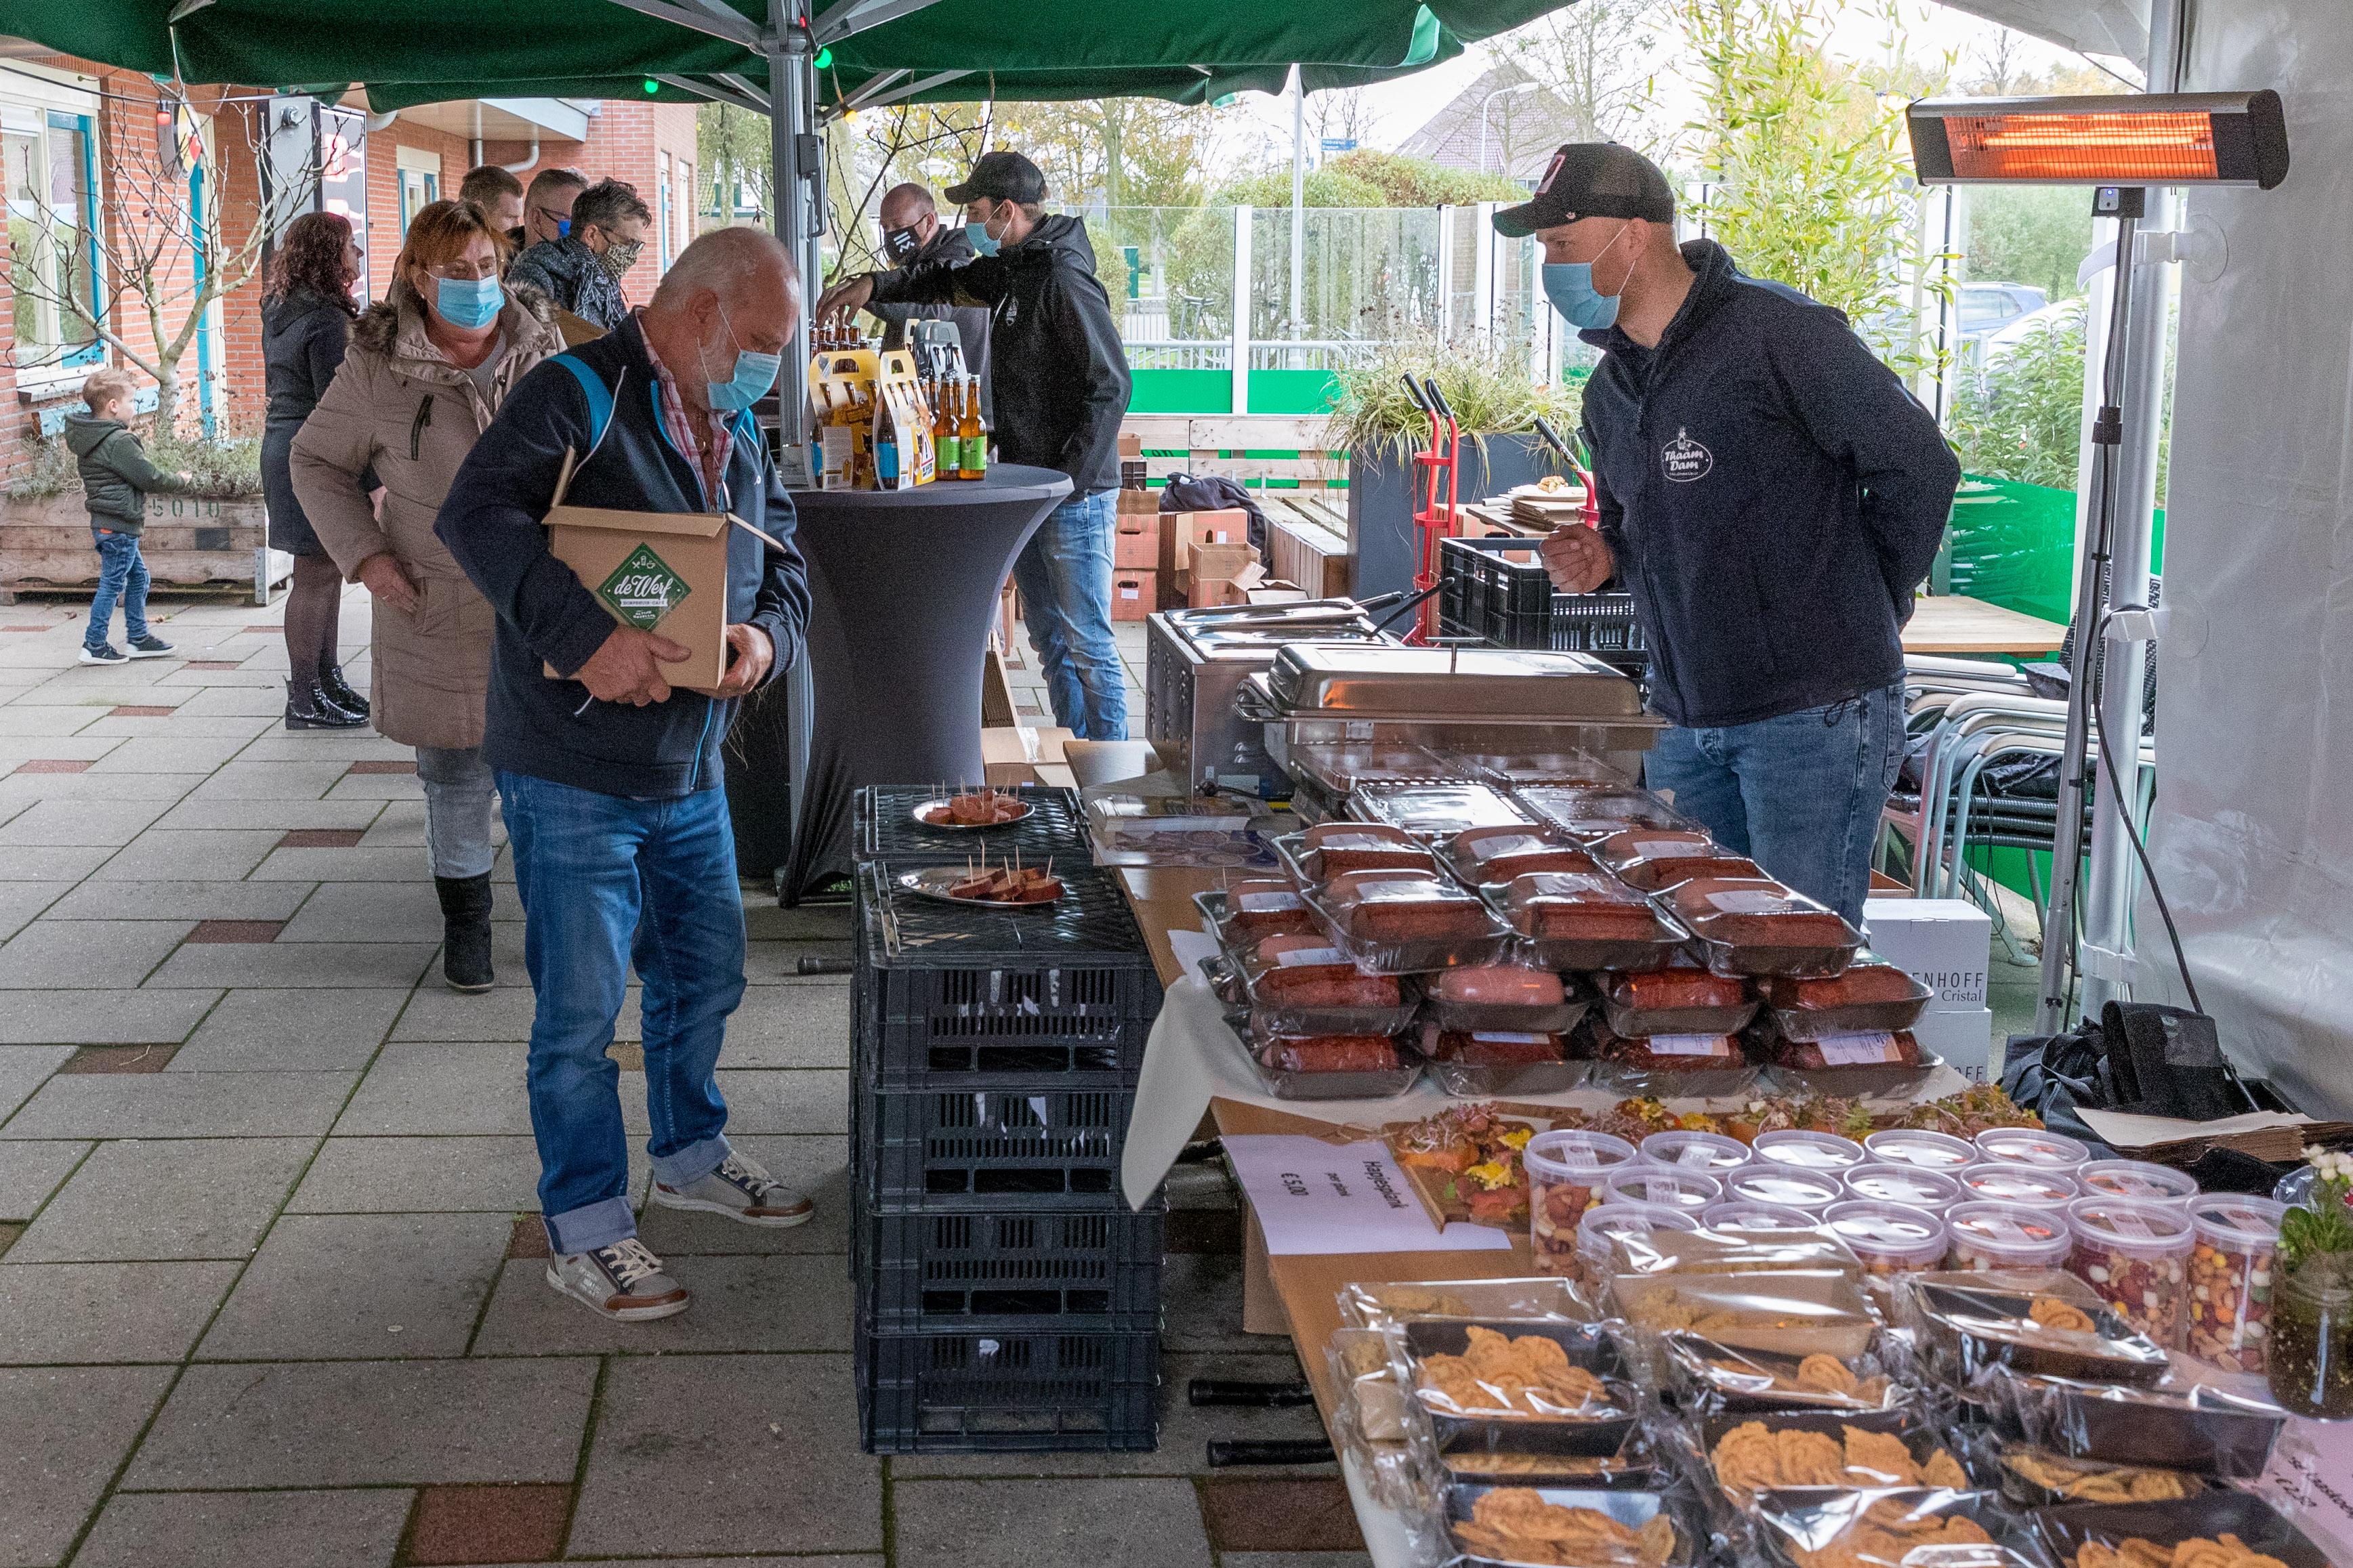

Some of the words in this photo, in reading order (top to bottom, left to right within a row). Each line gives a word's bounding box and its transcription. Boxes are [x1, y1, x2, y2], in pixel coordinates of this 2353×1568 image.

[1665, 450, 1703, 461] Thaam
[1670, 461, 1699, 471] Dam
[614, 575, 632, 595] de
[631, 574, 673, 601] Werf
[1942, 990, 1982, 1001] Cristal
[1363, 1161, 1409, 1208] Hapjesplank
